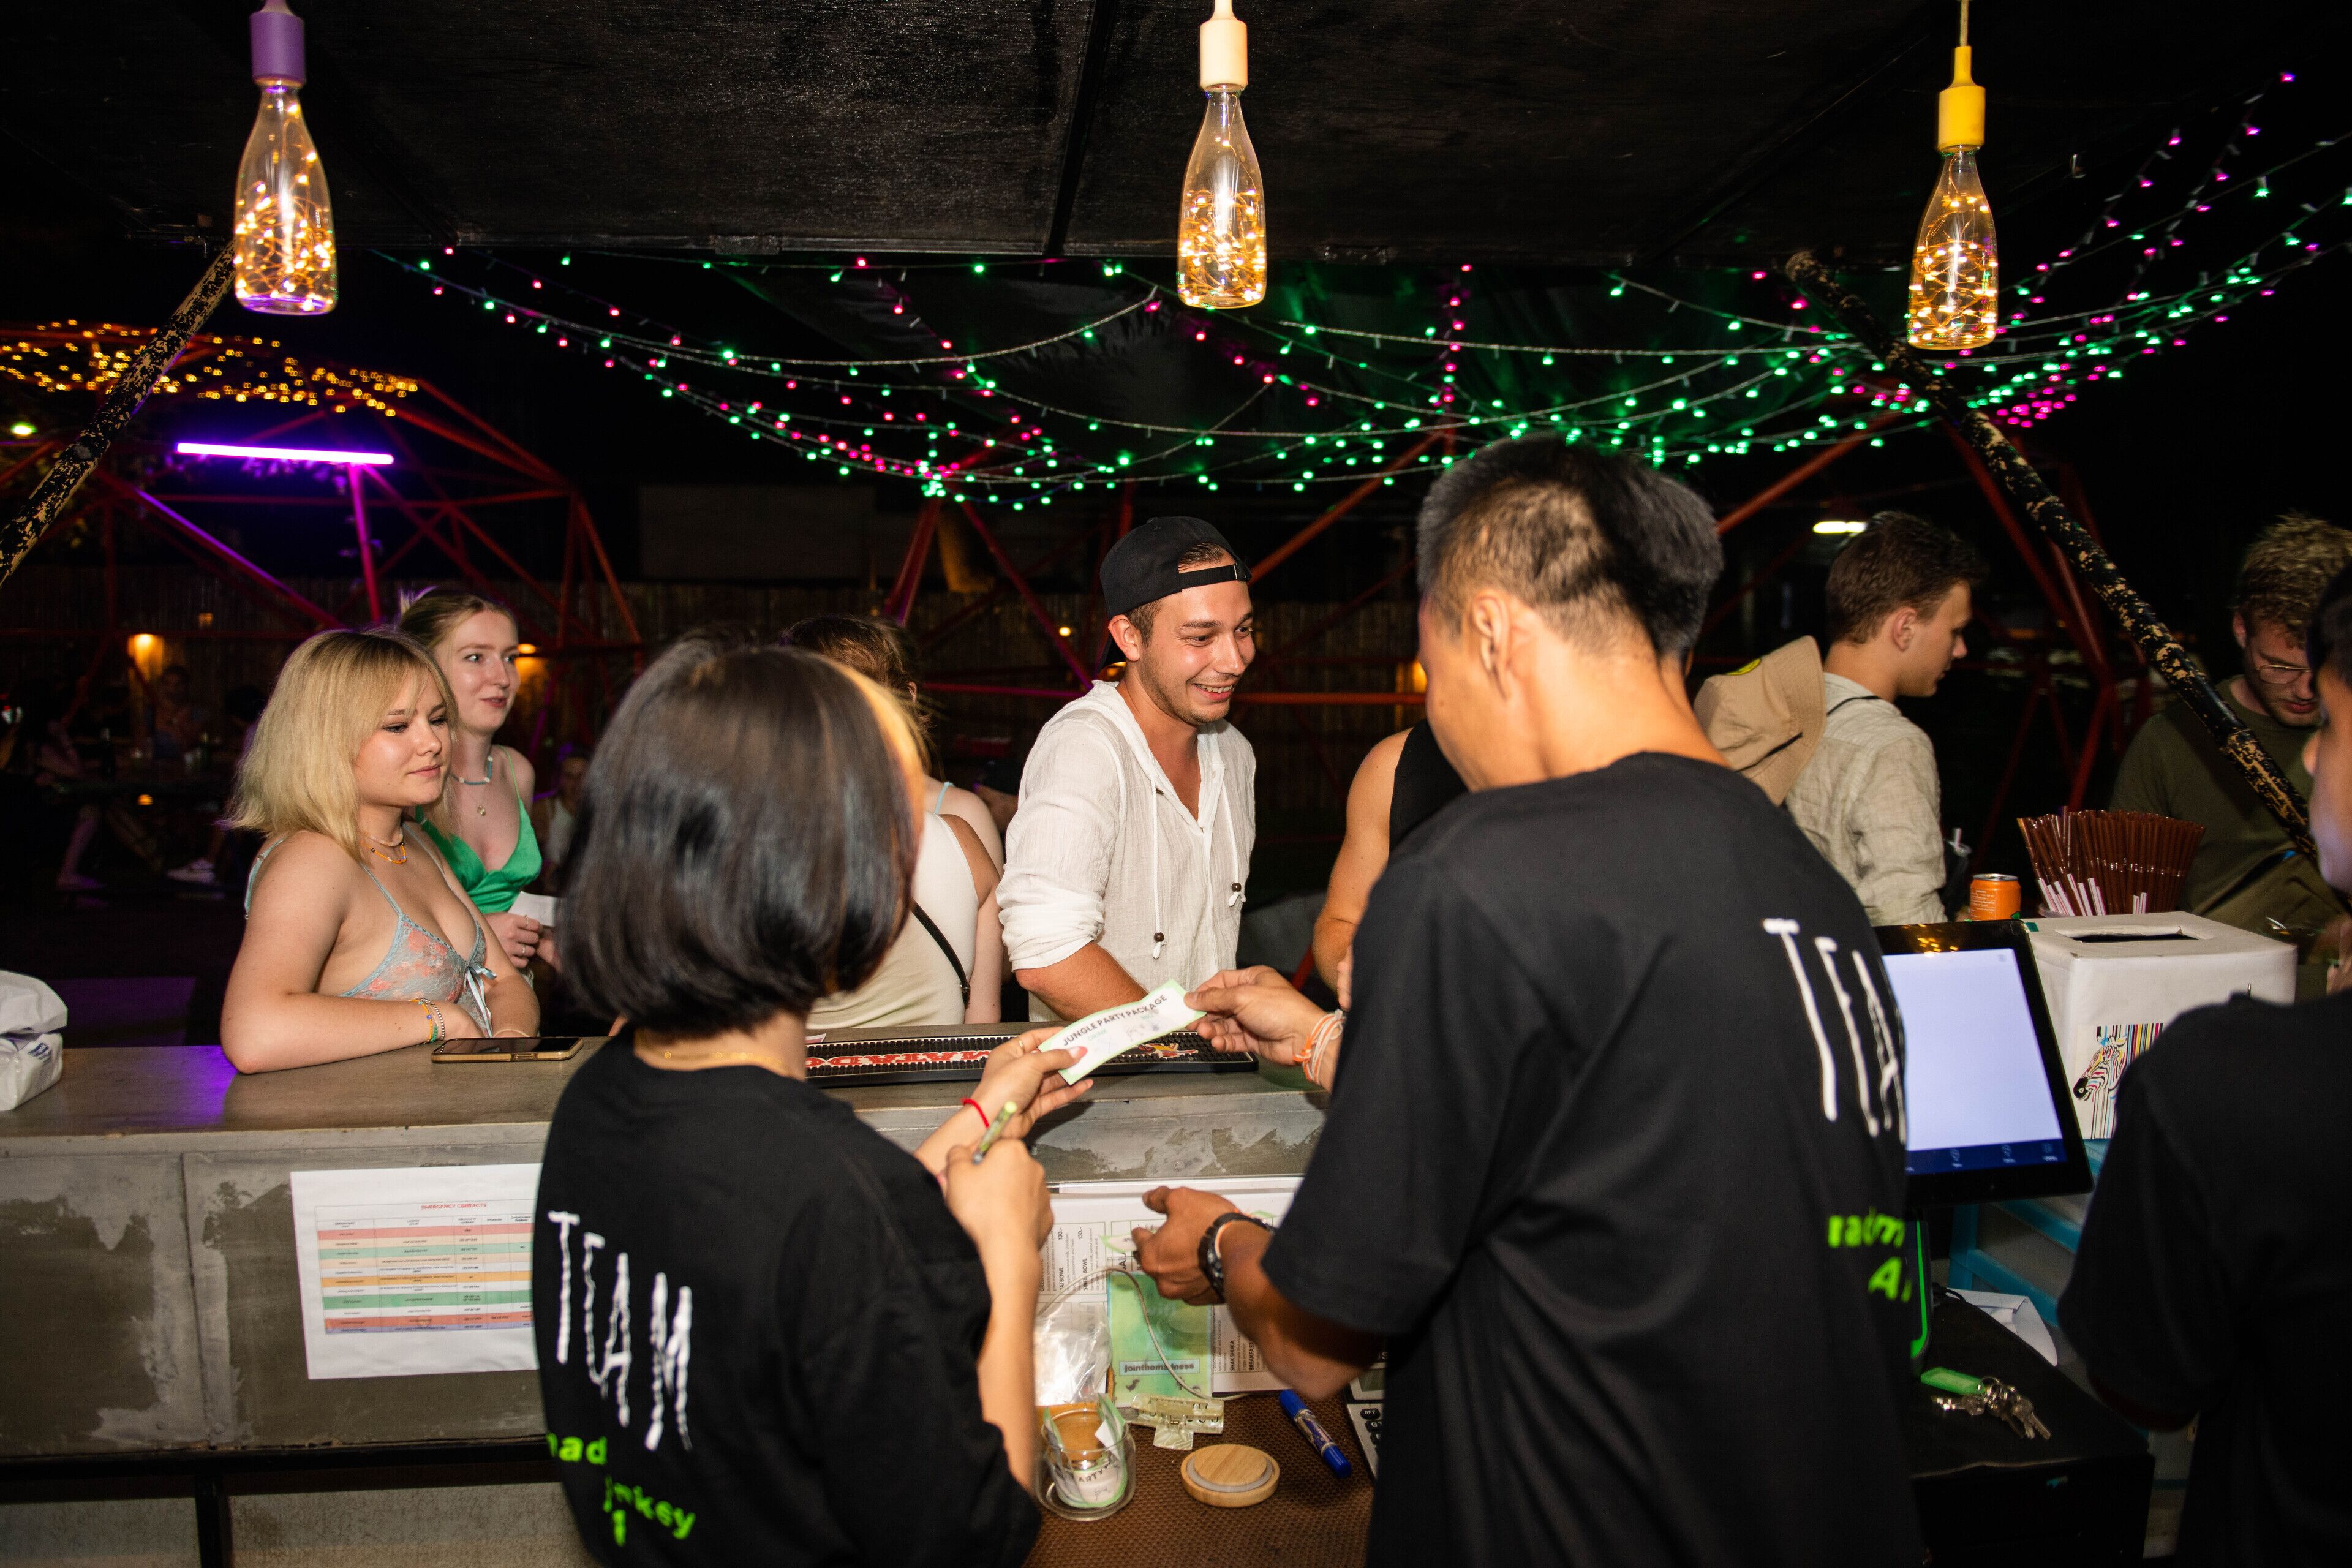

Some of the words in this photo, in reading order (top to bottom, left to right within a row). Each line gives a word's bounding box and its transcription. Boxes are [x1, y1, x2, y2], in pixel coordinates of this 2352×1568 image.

[1063, 1022, 1097, 1046] JUNGLE
[1098, 1011, 1126, 1026] PARTY
[1126, 993, 1167, 1016] PACKAGE
[548, 1210, 693, 1451] TEAM
[1079, 1469, 1102, 1482] ARTY
